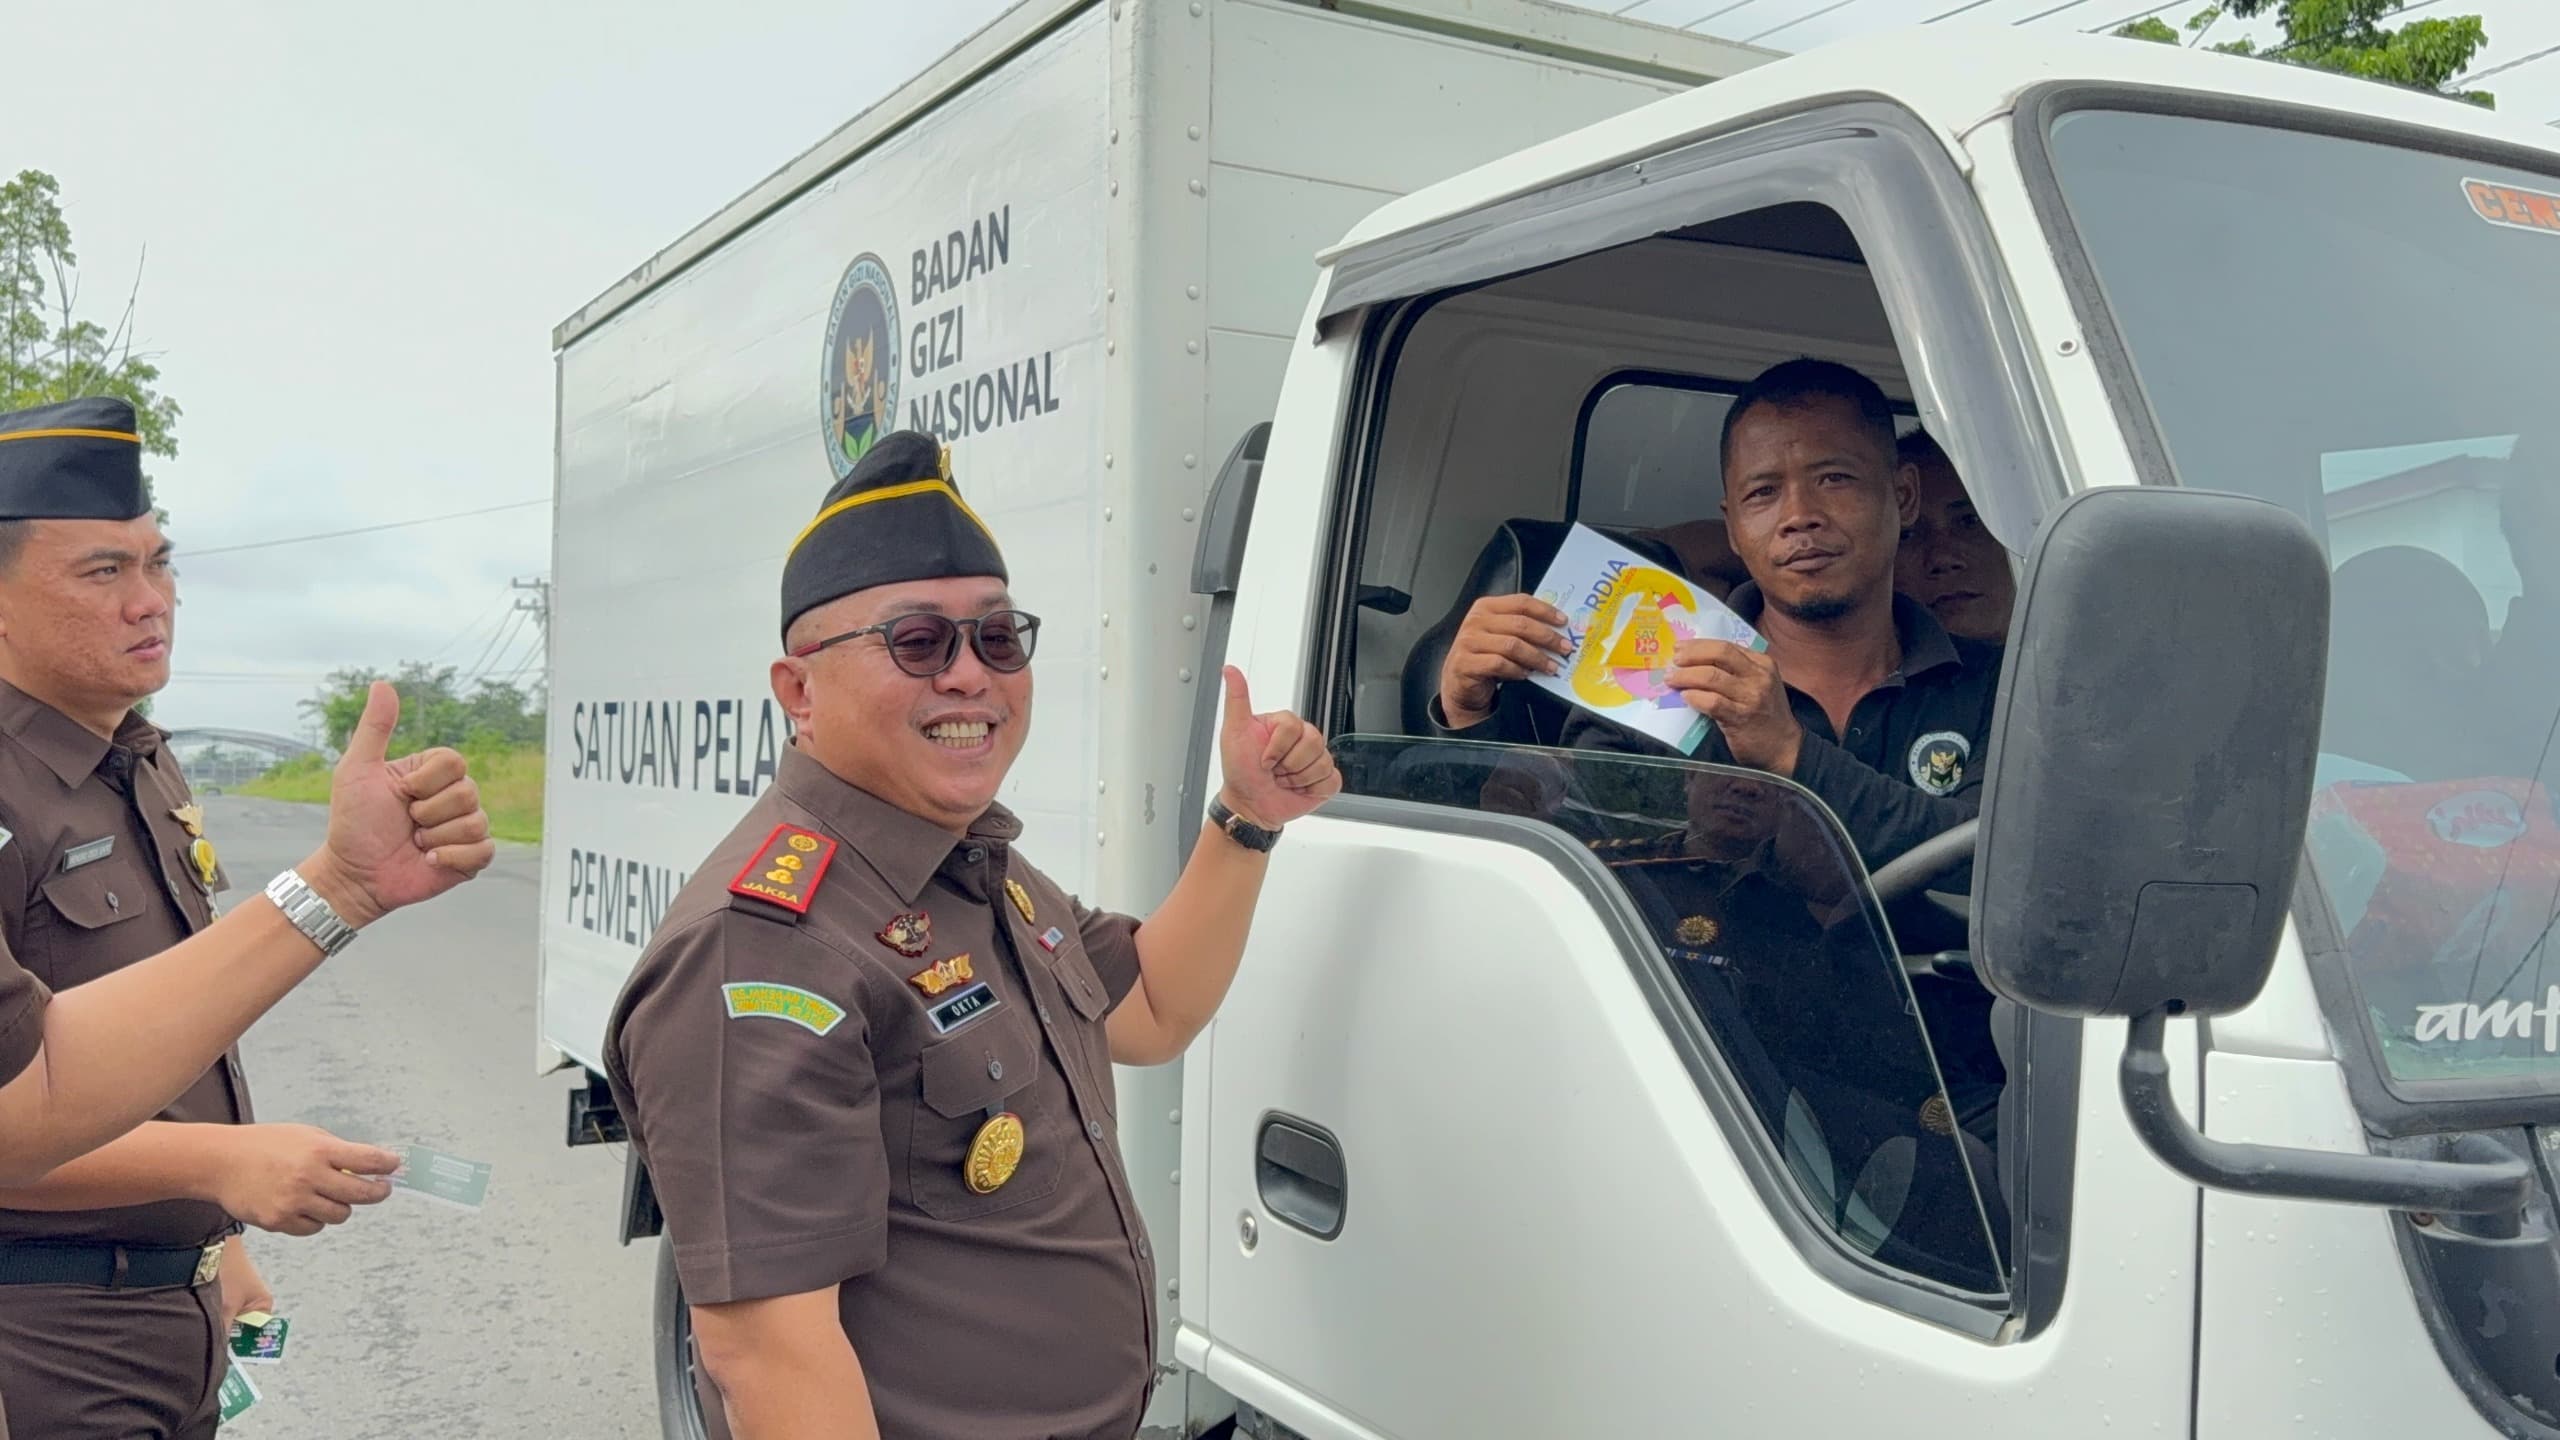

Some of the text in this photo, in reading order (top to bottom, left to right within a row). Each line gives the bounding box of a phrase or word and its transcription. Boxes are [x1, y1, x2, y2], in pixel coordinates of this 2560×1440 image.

[911, 203, 1010, 306] BADAN
[910, 304, 964, 379] GIZI
[910, 350, 1061, 443] NASIONAL
[1635, 629, 1658, 639] SAY
[572, 700, 682, 790] SATUAN
[742, 882, 799, 905] JAKSA
[951, 995, 982, 1017] OKTA
